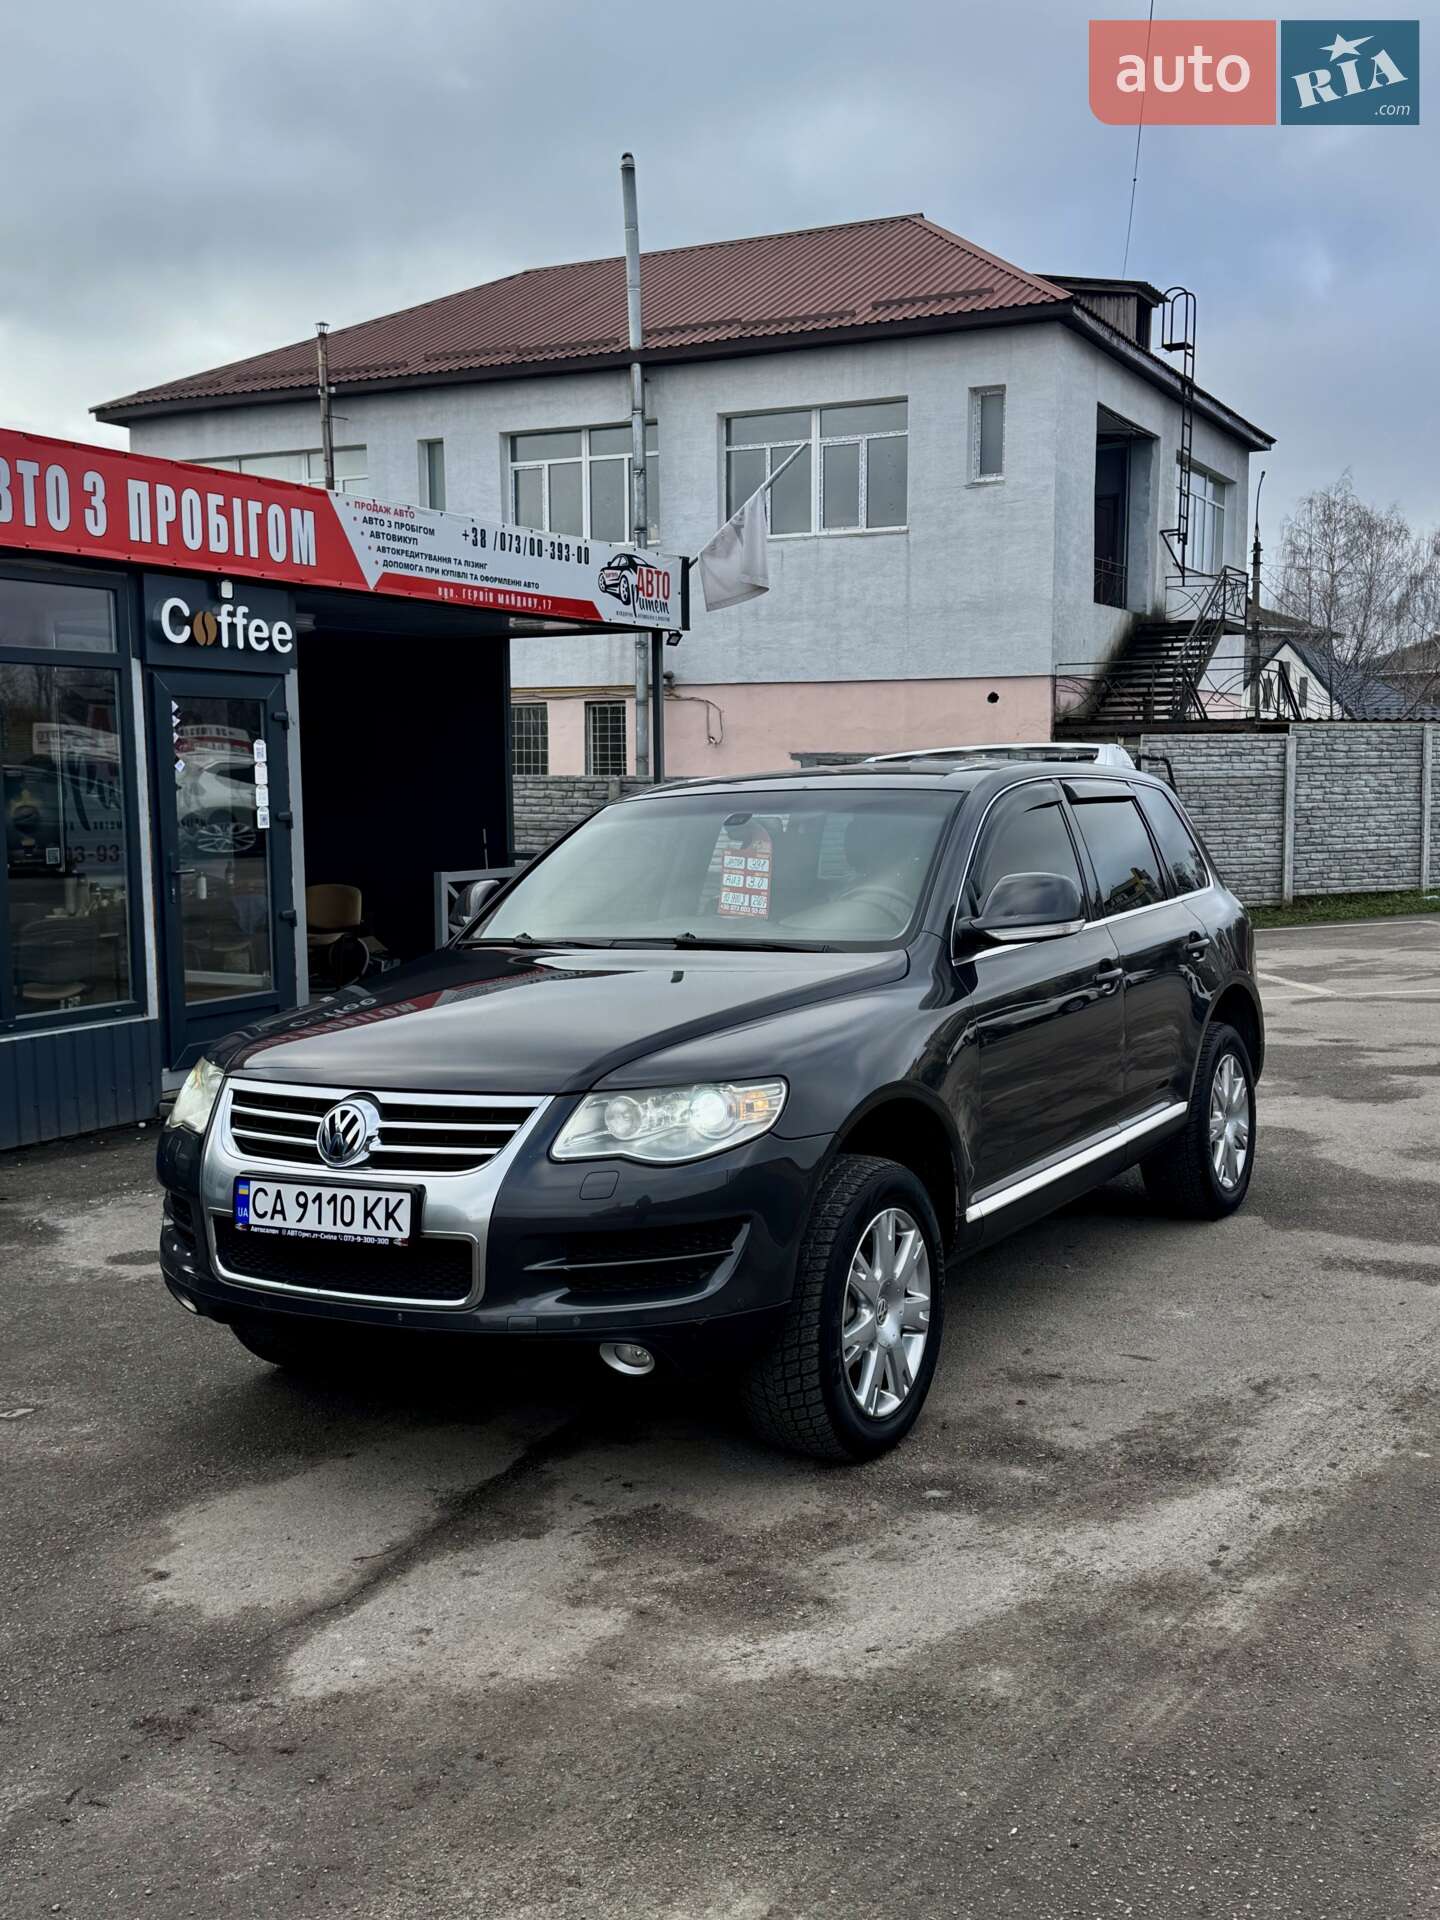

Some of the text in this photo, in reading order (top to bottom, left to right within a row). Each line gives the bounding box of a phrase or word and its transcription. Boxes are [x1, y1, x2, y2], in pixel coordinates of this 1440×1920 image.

[127, 478, 317, 566] ПРОБІГОМ
[354, 501, 415, 519] ПРОДАЖ АВТО
[362, 516, 385, 527] АВТО
[394, 521, 435, 536] ПРОБІГОМ
[369, 530, 419, 546] АВТОВИКУП
[376, 545, 488, 570] АВТОКРЕДИТУВАННЯ ТА ЛІЗИНГ
[462, 527, 590, 565] +38 /073/00-393-00
[382, 560, 540, 590] ДОПОМОГА ПРИ КУПІВЛІ ТА ОФОРМЛЕННІ АВТО
[637, 567, 671, 600] АВТО
[162, 597, 293, 653] Coffee
[237, 1207, 249, 1217] UA
[252, 1187, 404, 1232] CA 9110 KK
